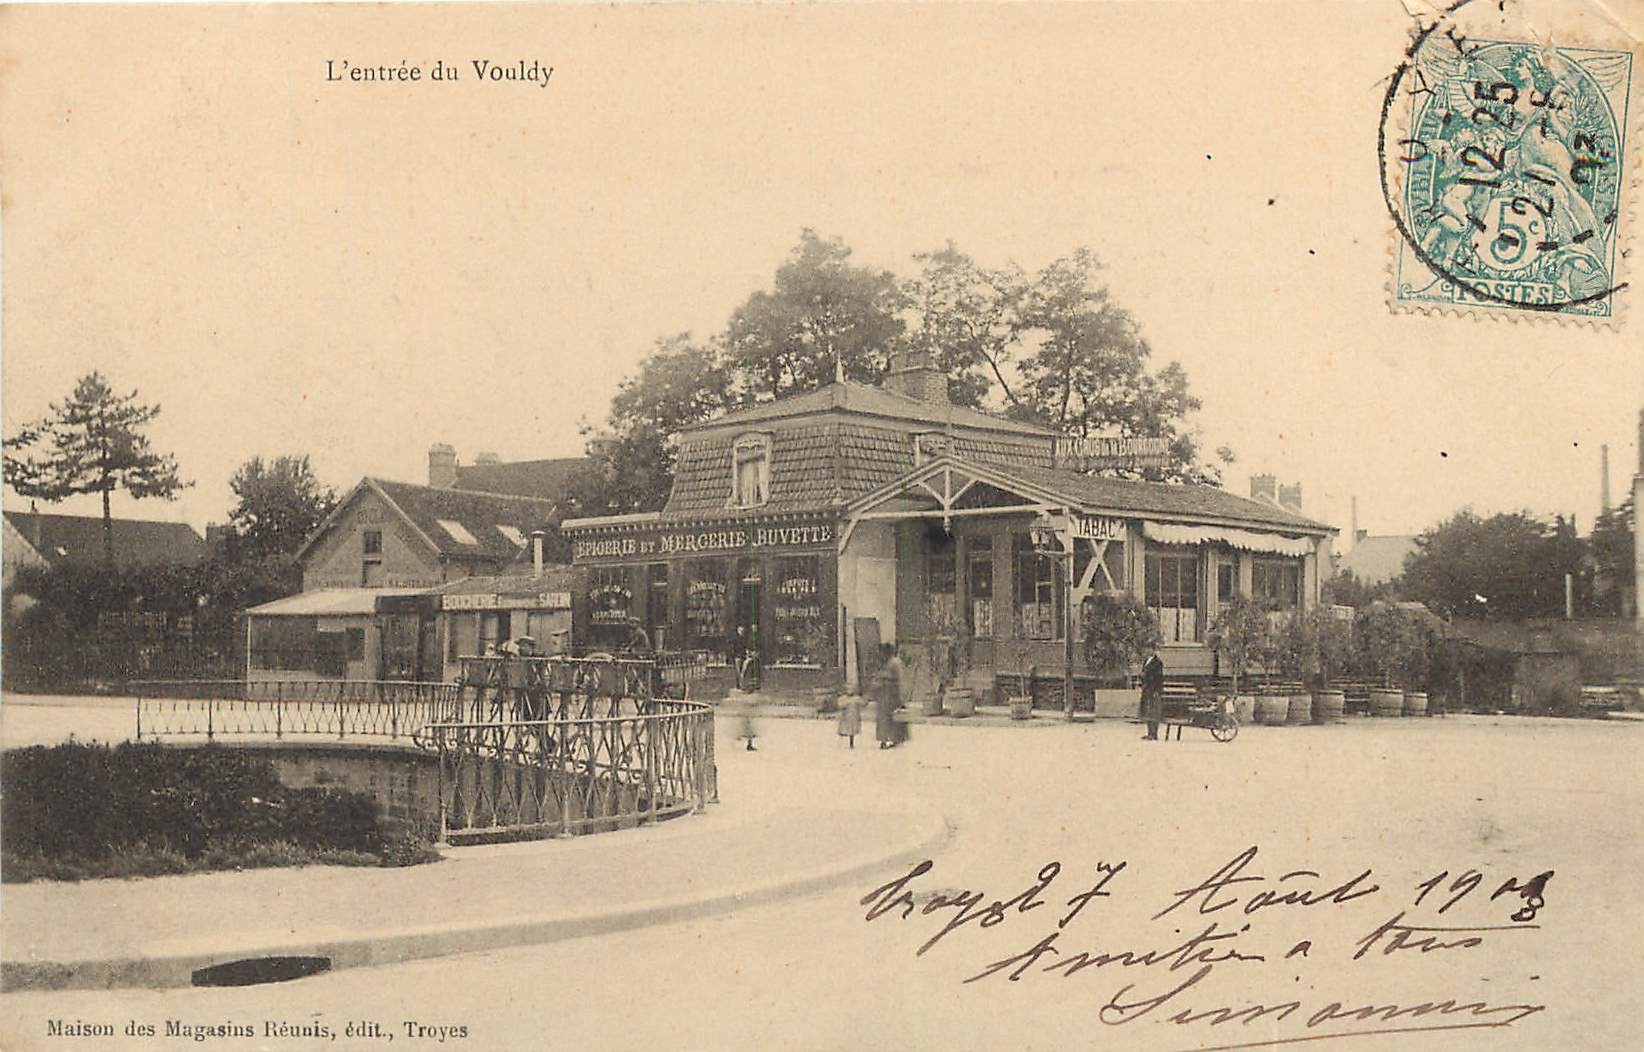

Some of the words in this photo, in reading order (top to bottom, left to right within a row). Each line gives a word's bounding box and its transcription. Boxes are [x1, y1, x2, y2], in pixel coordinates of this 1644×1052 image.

[1457, 276, 1552, 307] POSTES
[659, 530, 746, 554] MERCERIE
[751, 525, 832, 547] BUVETTE
[1079, 518, 1117, 538] TABAC
